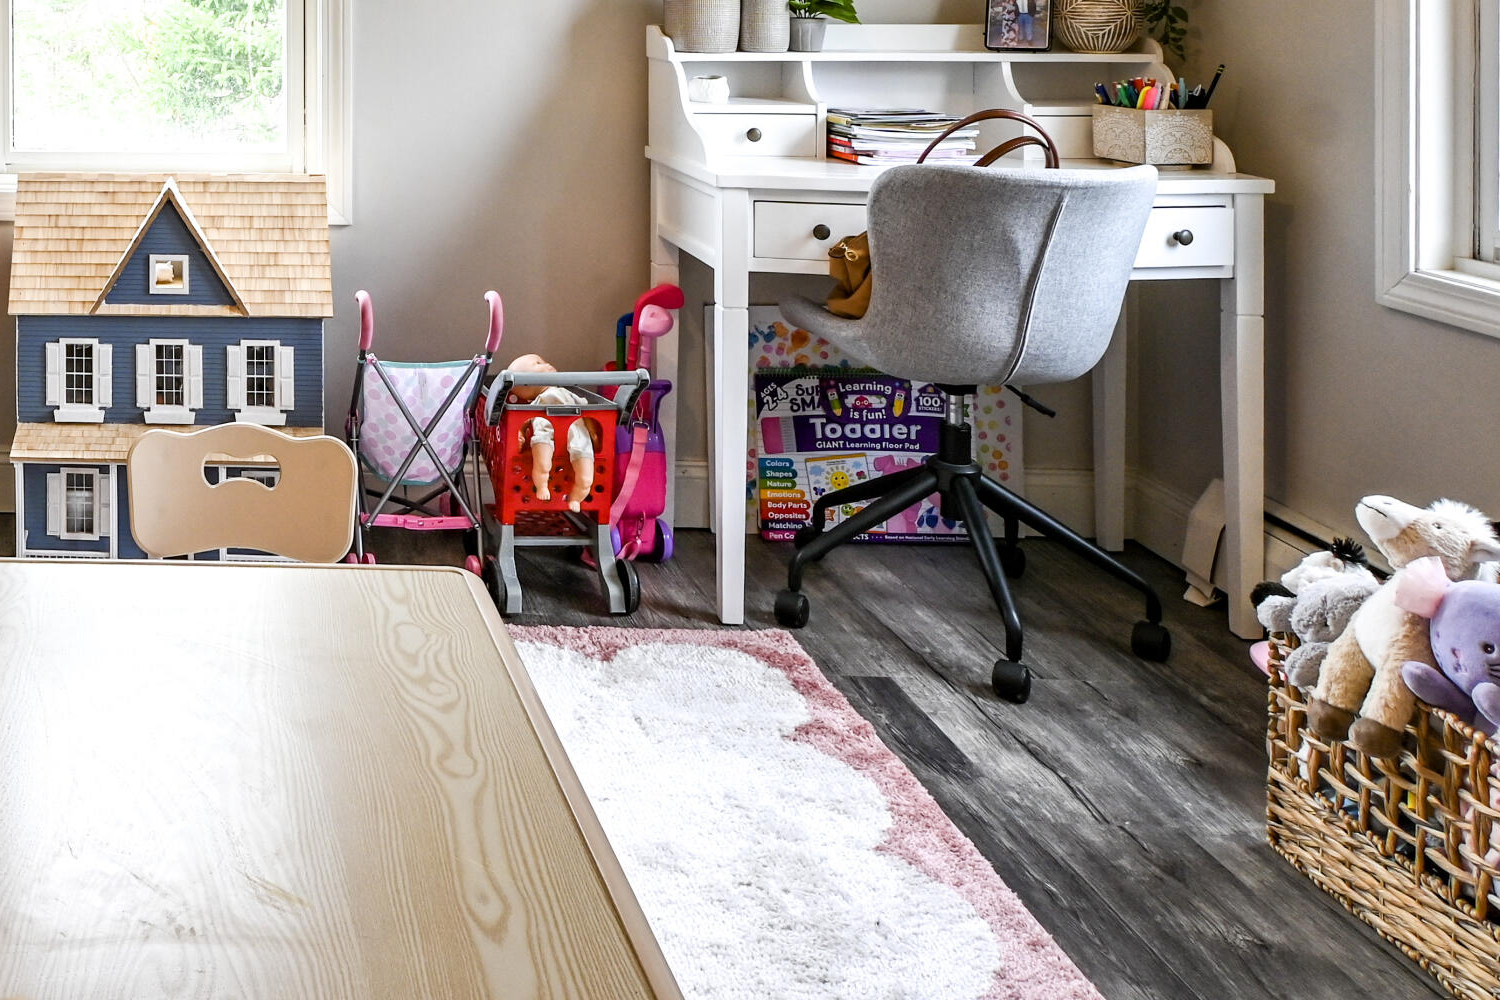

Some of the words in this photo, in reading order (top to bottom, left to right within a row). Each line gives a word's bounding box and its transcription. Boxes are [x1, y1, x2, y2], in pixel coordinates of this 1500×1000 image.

[760, 382, 776, 398] AGES
[838, 381, 892, 394] Learning
[763, 387, 788, 411] 2-4
[850, 409, 859, 419] is
[862, 409, 887, 421] fun!
[816, 441, 844, 449] GIANT
[904, 442, 920, 450] Pad
[766, 470, 793, 478] Shapes
[767, 501, 787, 510] Body
[787, 501, 808, 509] Parts
[768, 511, 806, 519] Opposites
